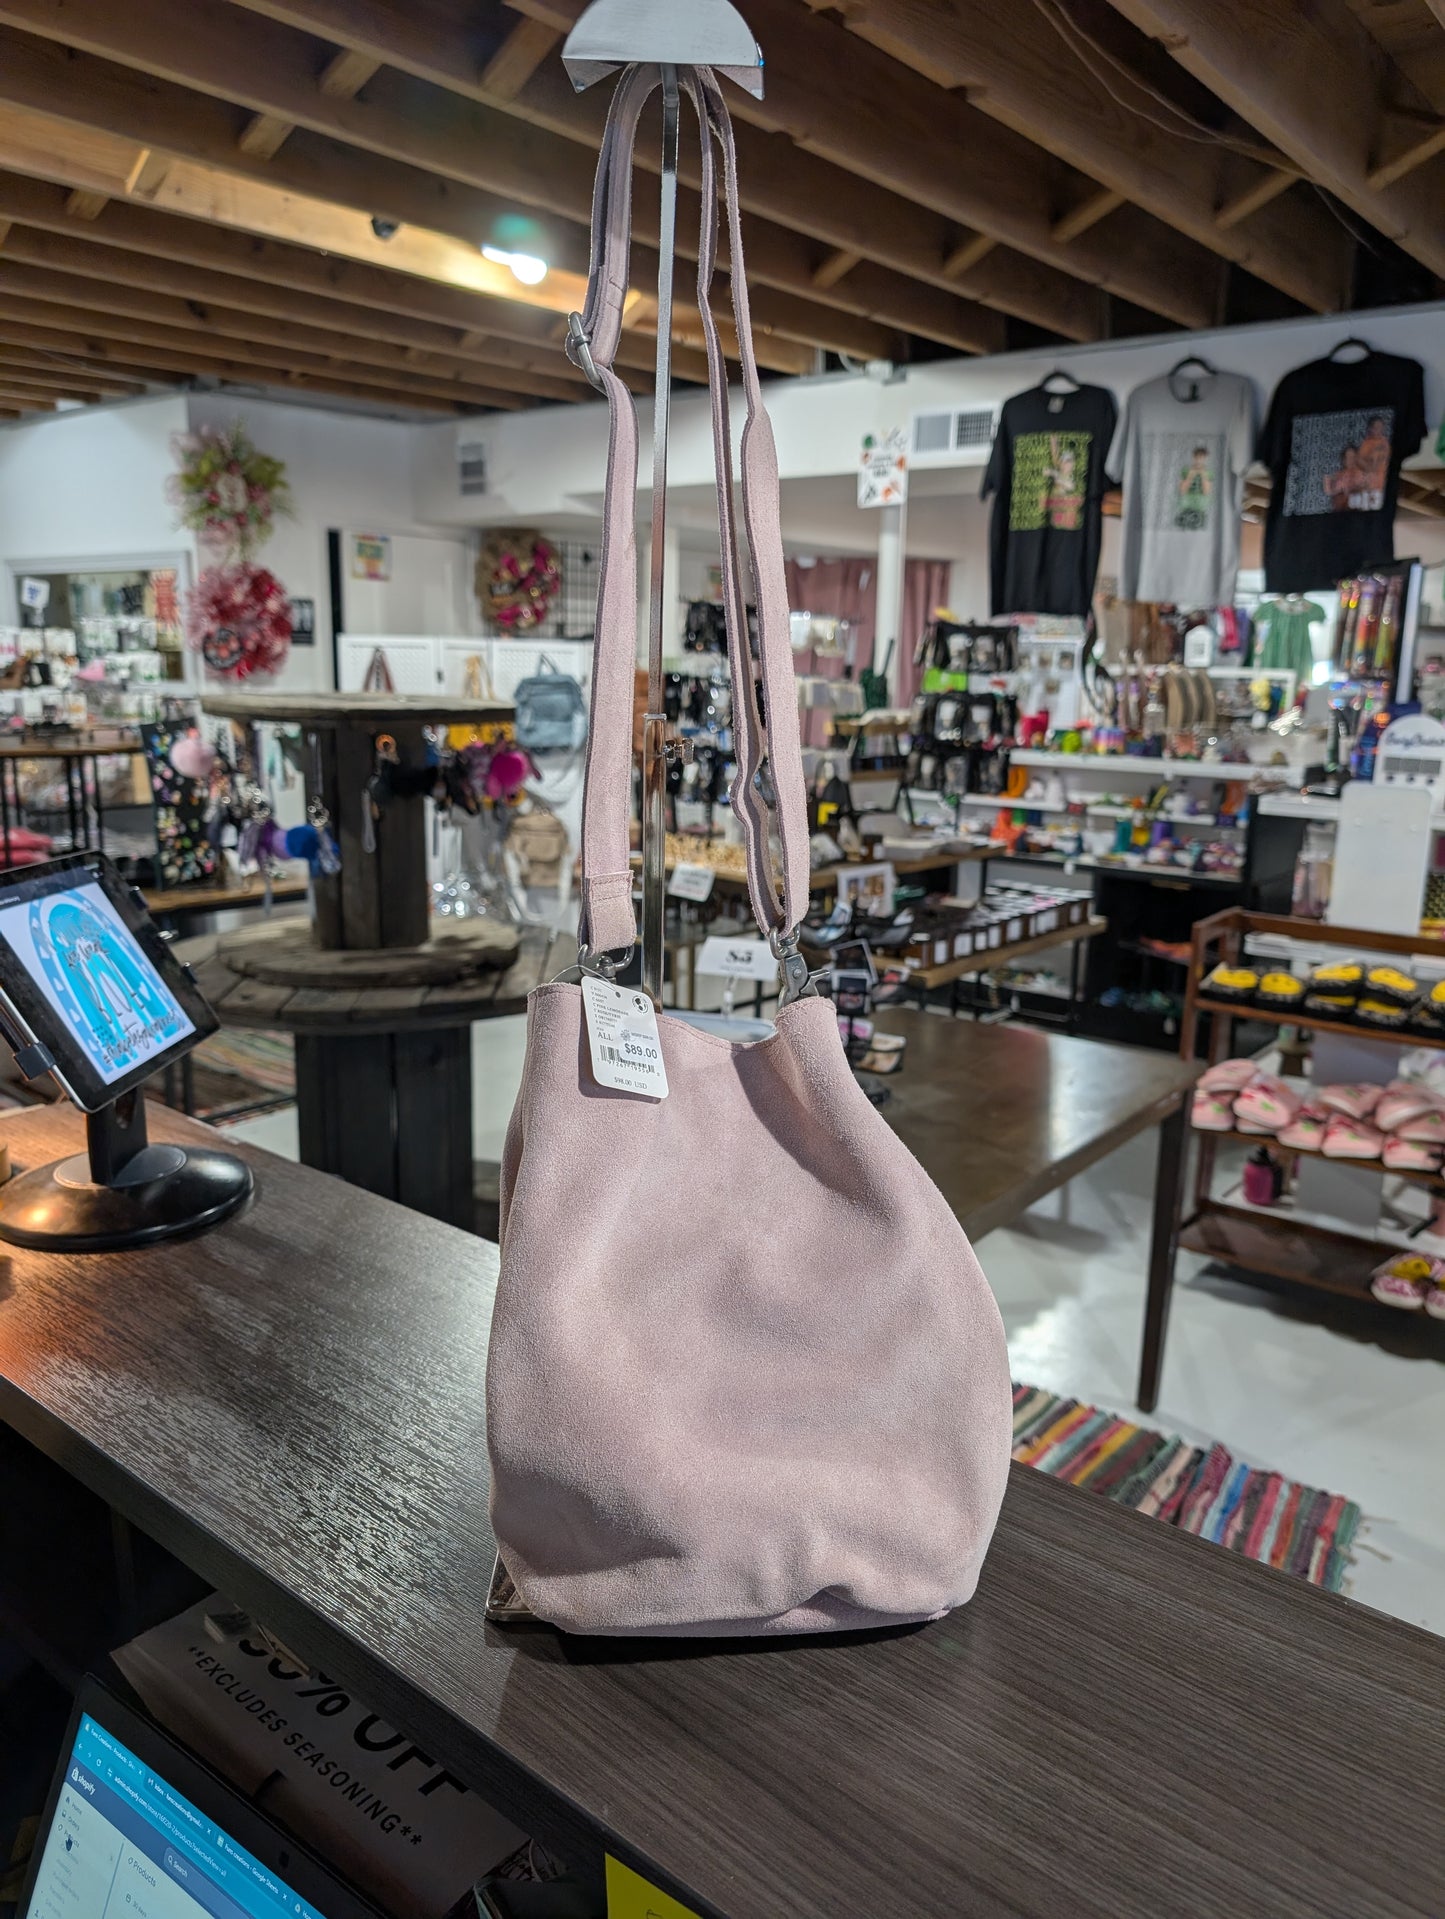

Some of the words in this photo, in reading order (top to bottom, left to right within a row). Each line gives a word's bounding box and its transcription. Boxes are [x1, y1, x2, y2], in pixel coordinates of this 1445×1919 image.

[625, 1042, 658, 1059] $89.00
[634, 1081, 648, 1089] USD
[78, 1774, 96, 1796] shopify
[133, 1861, 157, 1887] Products
[174, 1860, 188, 1878] Search
